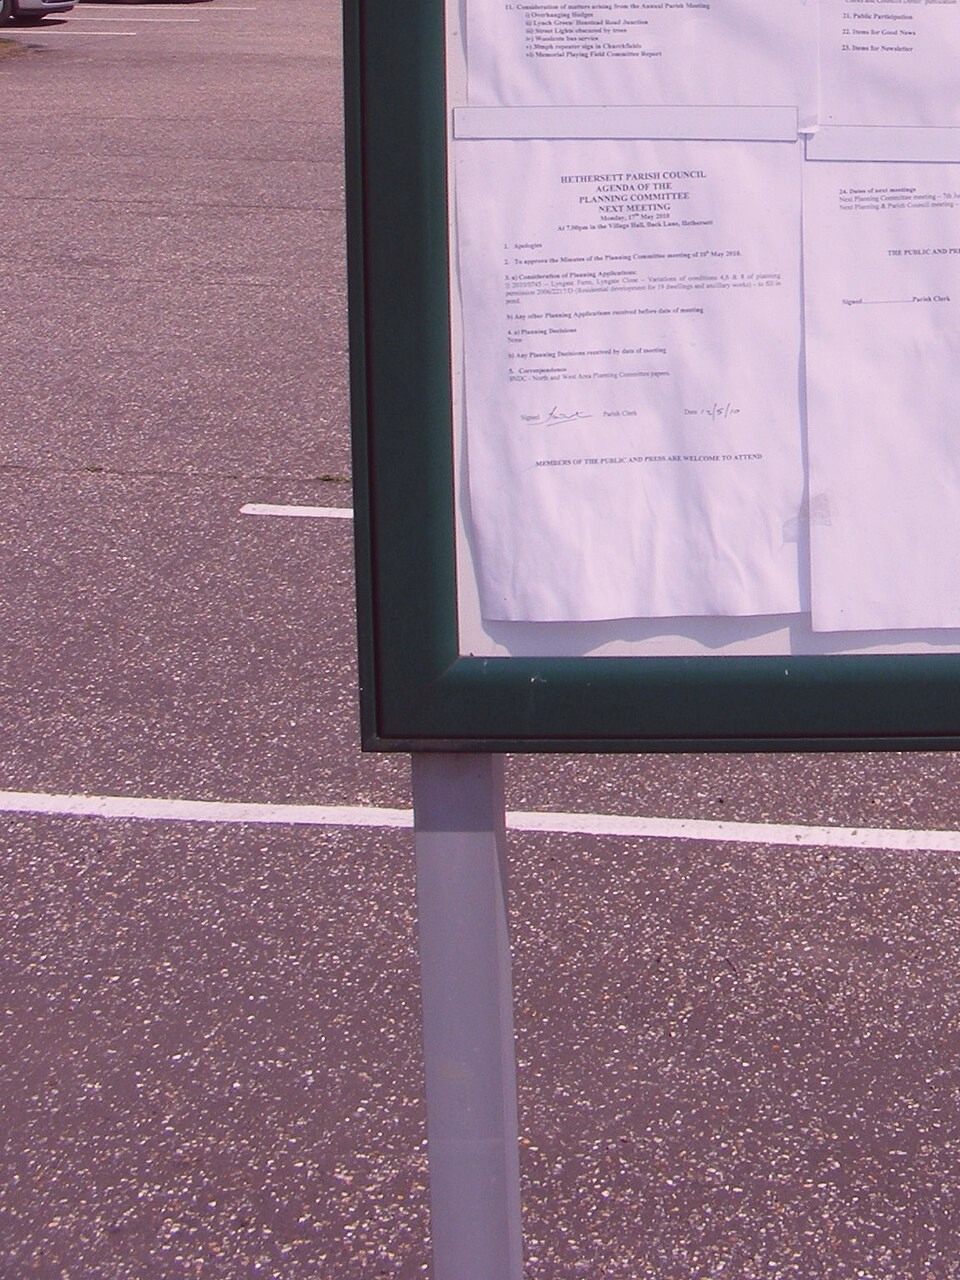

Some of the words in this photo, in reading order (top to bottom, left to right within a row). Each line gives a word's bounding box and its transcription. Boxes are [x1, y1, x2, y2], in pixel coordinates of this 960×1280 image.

[560, 173, 624, 184] HETHERSETT
[625, 171, 661, 182] PARISH
[662, 170, 707, 180] COUNCIL
[596, 183, 636, 193] AGENDA
[636, 182, 651, 191] OF
[652, 181, 673, 191] THE
[579, 194, 629, 204] PLANNING
[629, 191, 689, 202] COMMITTEE
[598, 204, 624, 213] NEXT
[626, 203, 671, 213] MEETING
